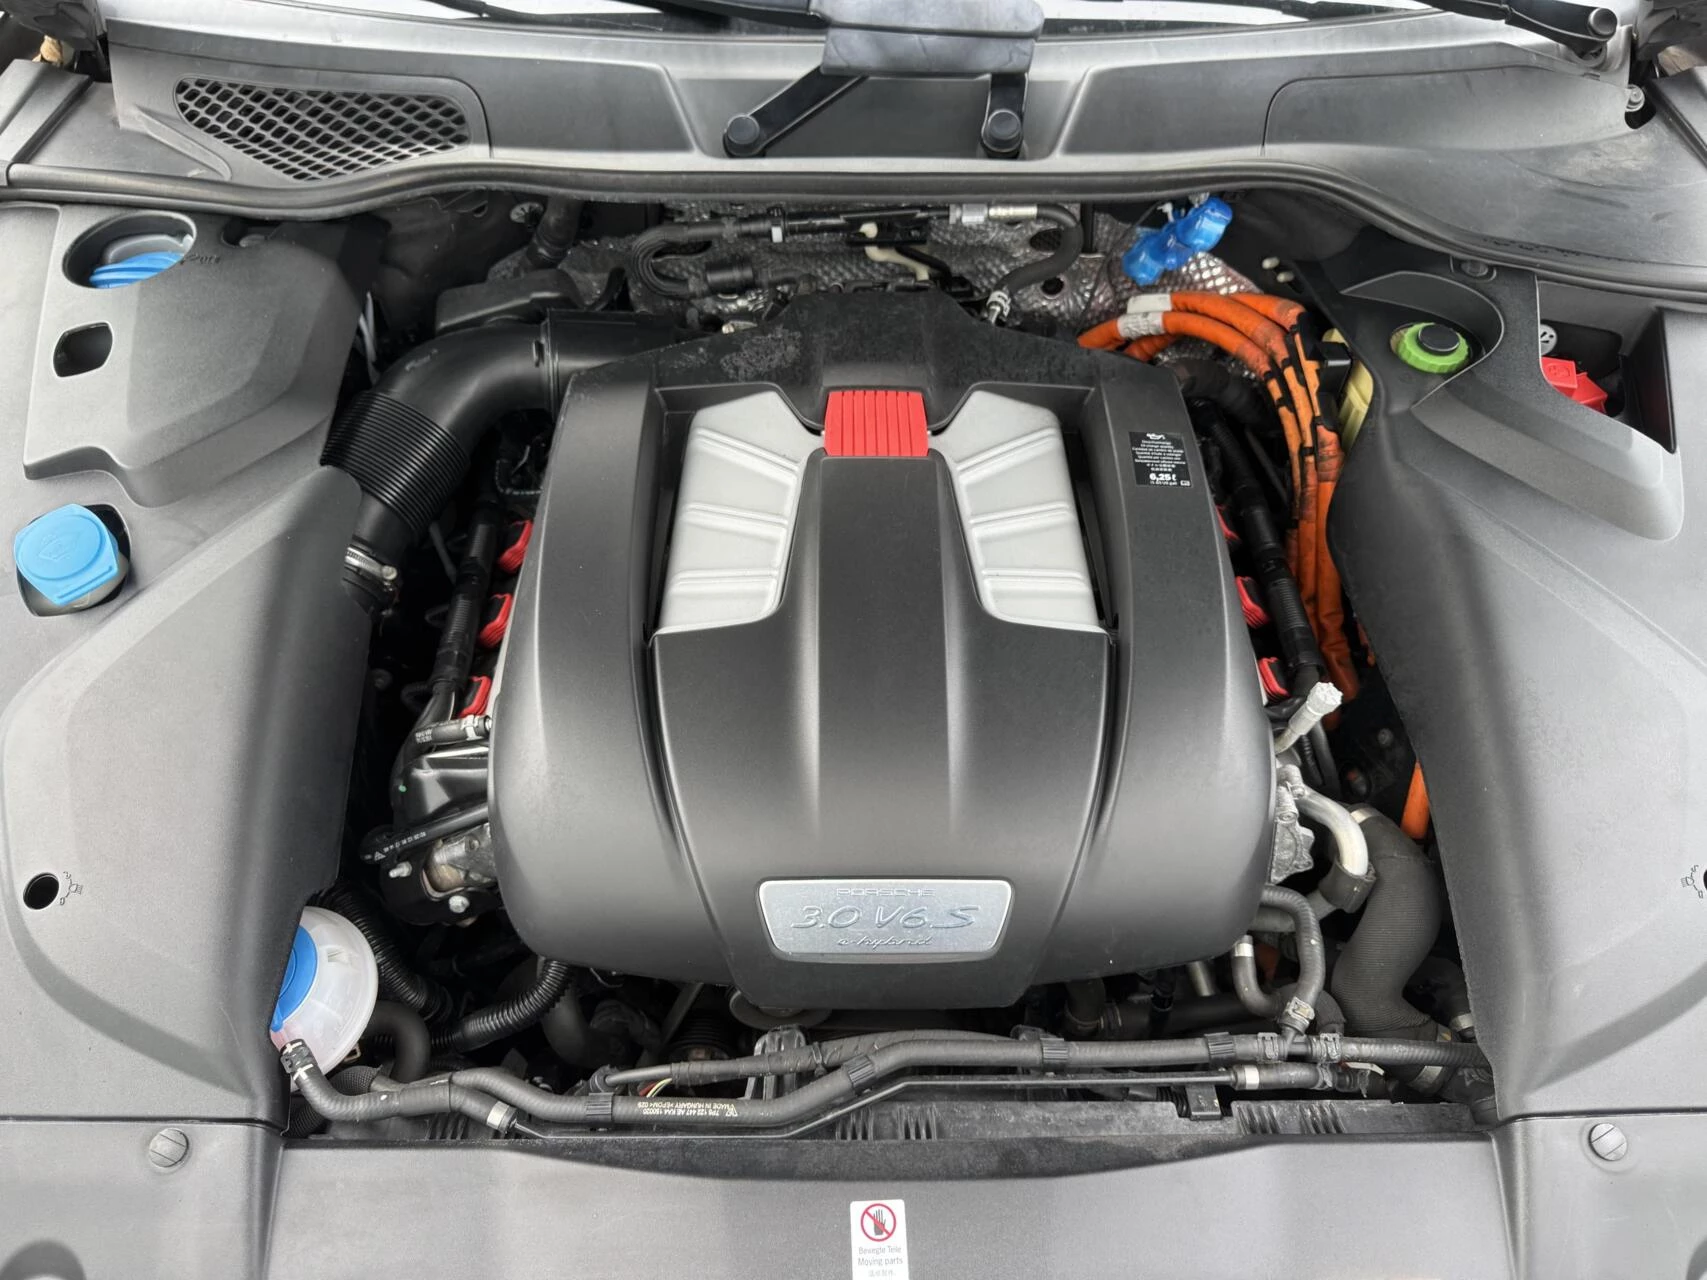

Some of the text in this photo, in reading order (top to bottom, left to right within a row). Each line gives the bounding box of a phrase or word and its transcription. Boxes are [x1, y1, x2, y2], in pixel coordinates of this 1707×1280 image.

[1149, 472, 1172, 482] 6,25
[836, 887, 937, 897] PORSCHE
[791, 905, 981, 928] 3.0 V6 S
[712, 1102, 732, 1110] MADE
[857, 1256, 903, 1267] Moving parts
